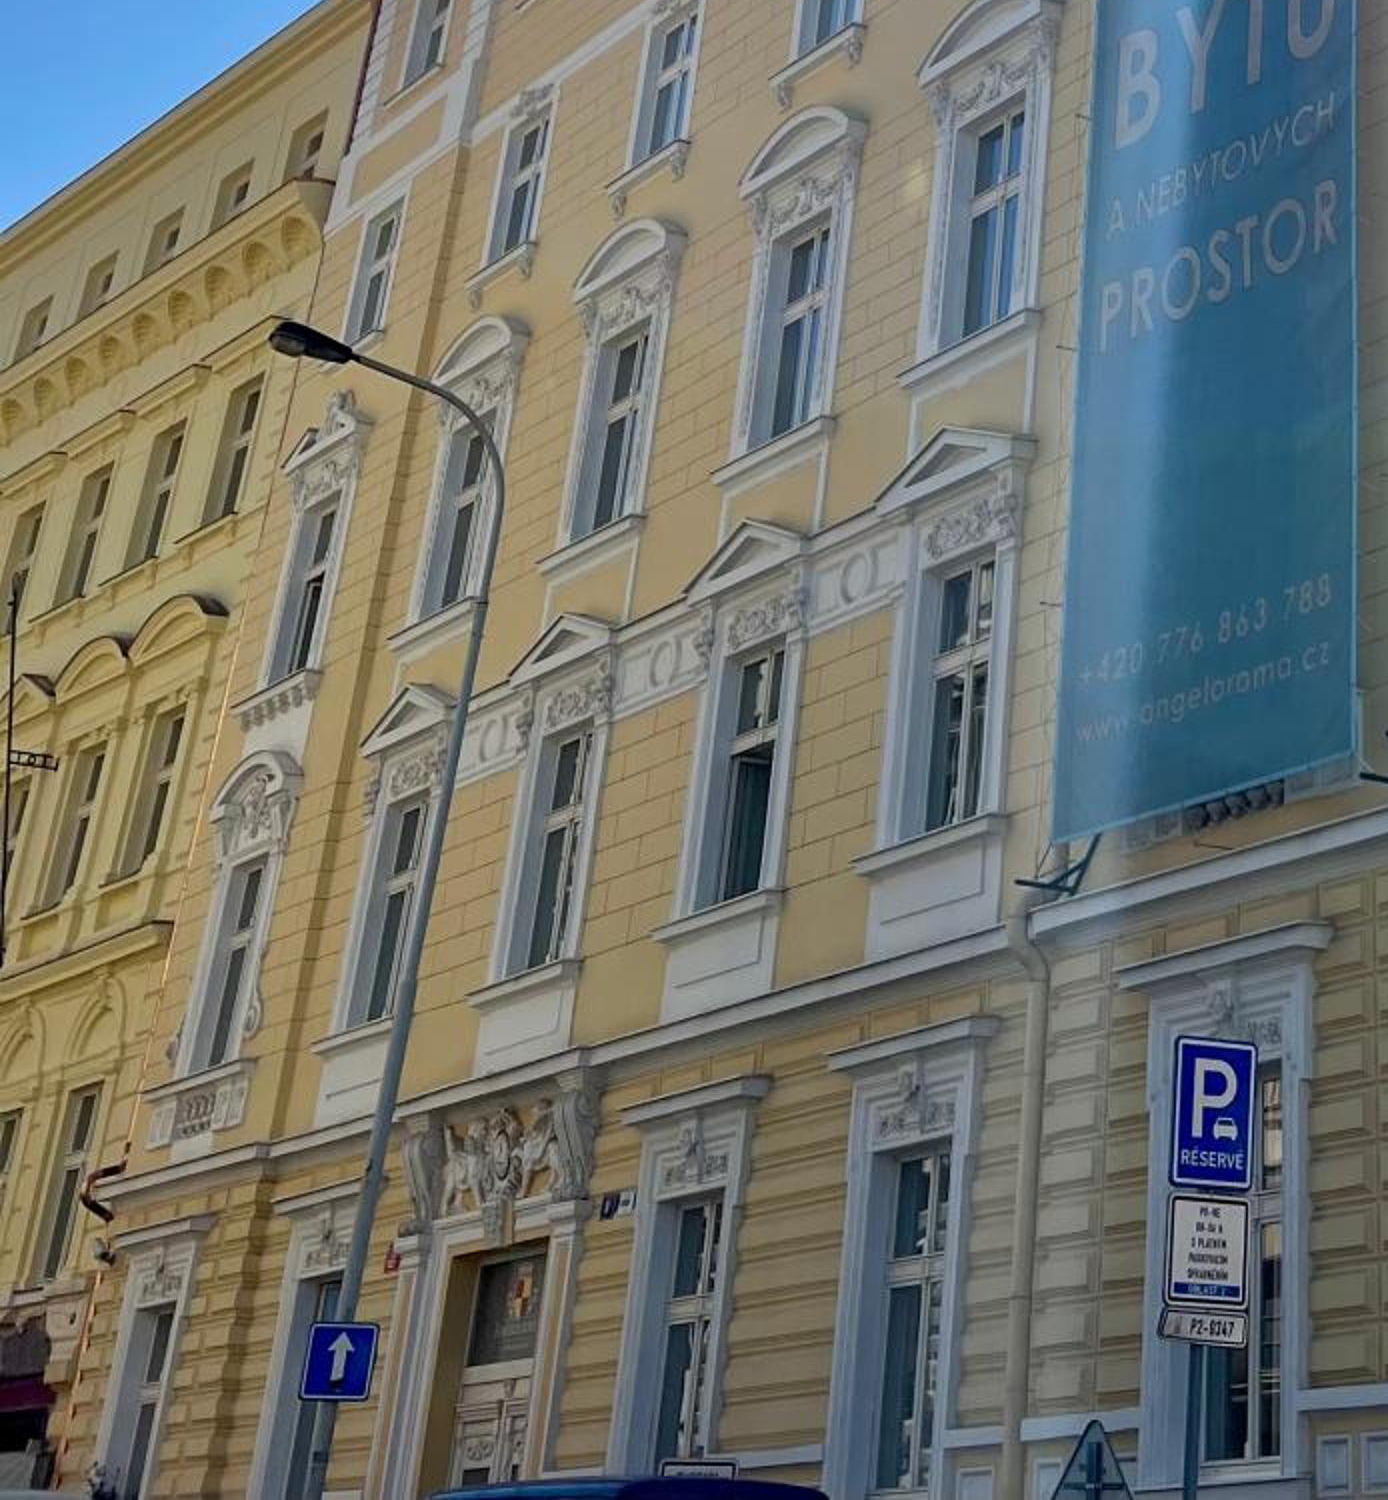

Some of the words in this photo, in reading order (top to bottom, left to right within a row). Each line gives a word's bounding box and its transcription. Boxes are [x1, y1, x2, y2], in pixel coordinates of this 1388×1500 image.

[1105, 199, 1126, 242] A
[1101, 179, 1338, 352] PROSTOR
[1157, 622, 1204, 664] 776
[1218, 598, 1266, 644] 863
[1282, 573, 1332, 621] 788
[1192, 1057, 1238, 1138] P
